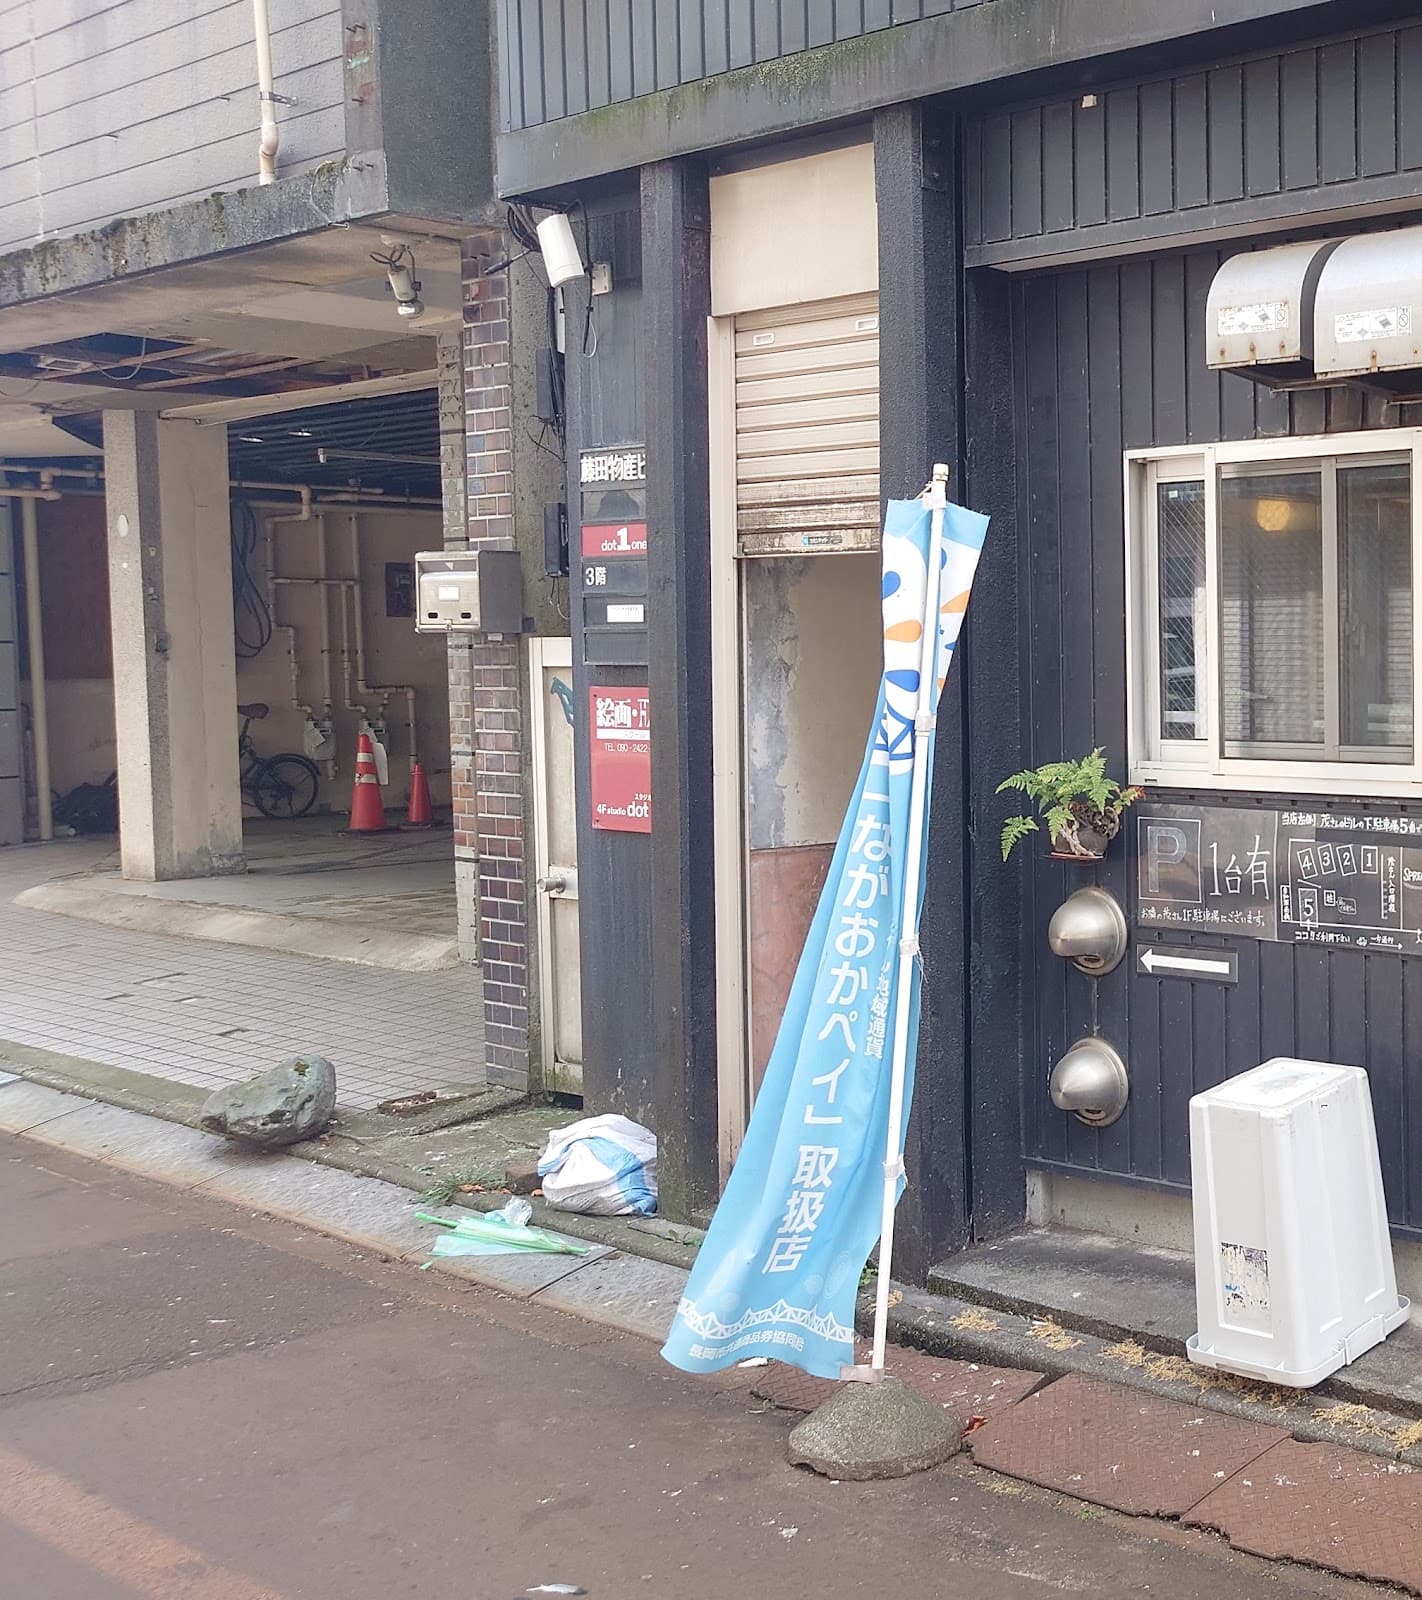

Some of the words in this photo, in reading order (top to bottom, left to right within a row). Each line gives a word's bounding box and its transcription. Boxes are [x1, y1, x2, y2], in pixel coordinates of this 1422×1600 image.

[585, 567, 606, 585] 3階
[603, 742, 616, 752] TEL
[597, 804, 607, 814] 4F
[607, 807, 626, 816] studio
[627, 801, 649, 817] dot
[1147, 826, 1187, 893] P
[1302, 855, 1313, 870] 4
[1322, 852, 1331, 867] 3
[1342, 852, 1351, 866] 2
[1366, 852, 1373, 867] 1
[1303, 898, 1314, 917] 5
